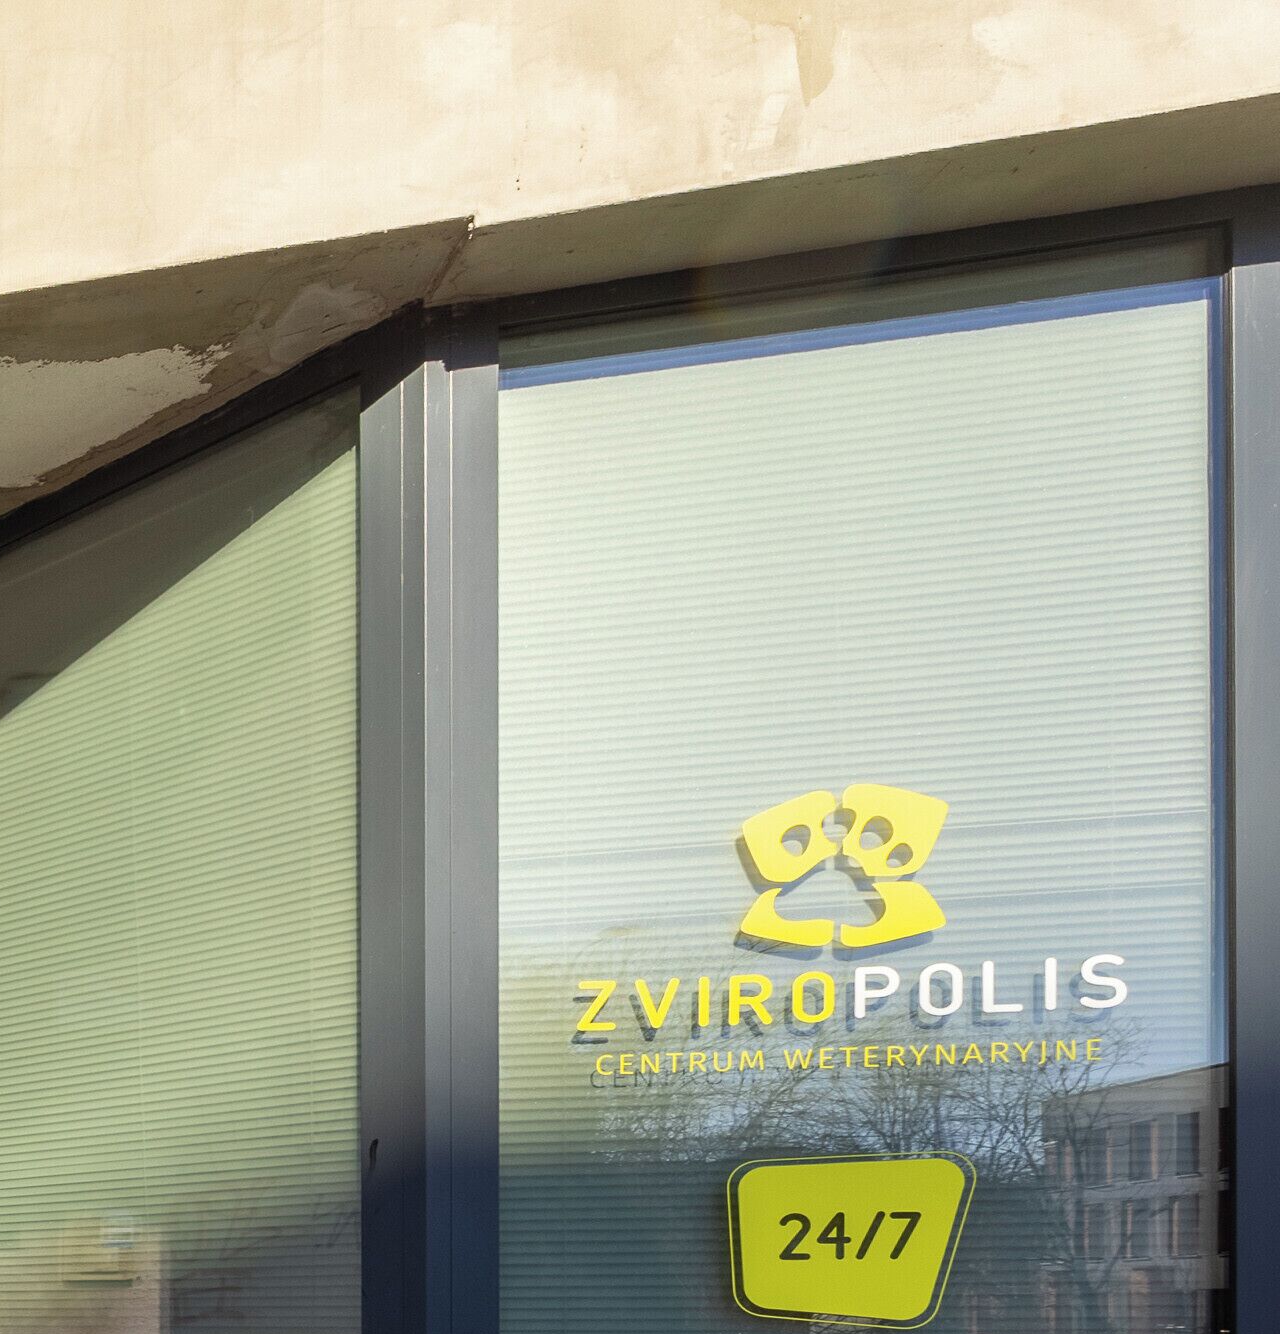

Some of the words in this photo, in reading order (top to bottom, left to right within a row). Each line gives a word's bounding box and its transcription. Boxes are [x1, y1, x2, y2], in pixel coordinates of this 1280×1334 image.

[575, 952, 1130, 1033] ZVIROPOLIS
[595, 1048, 765, 1077] CENTRUM
[783, 1037, 1104, 1071] WETERYNARYJNE
[778, 1210, 923, 1261] 24/7
